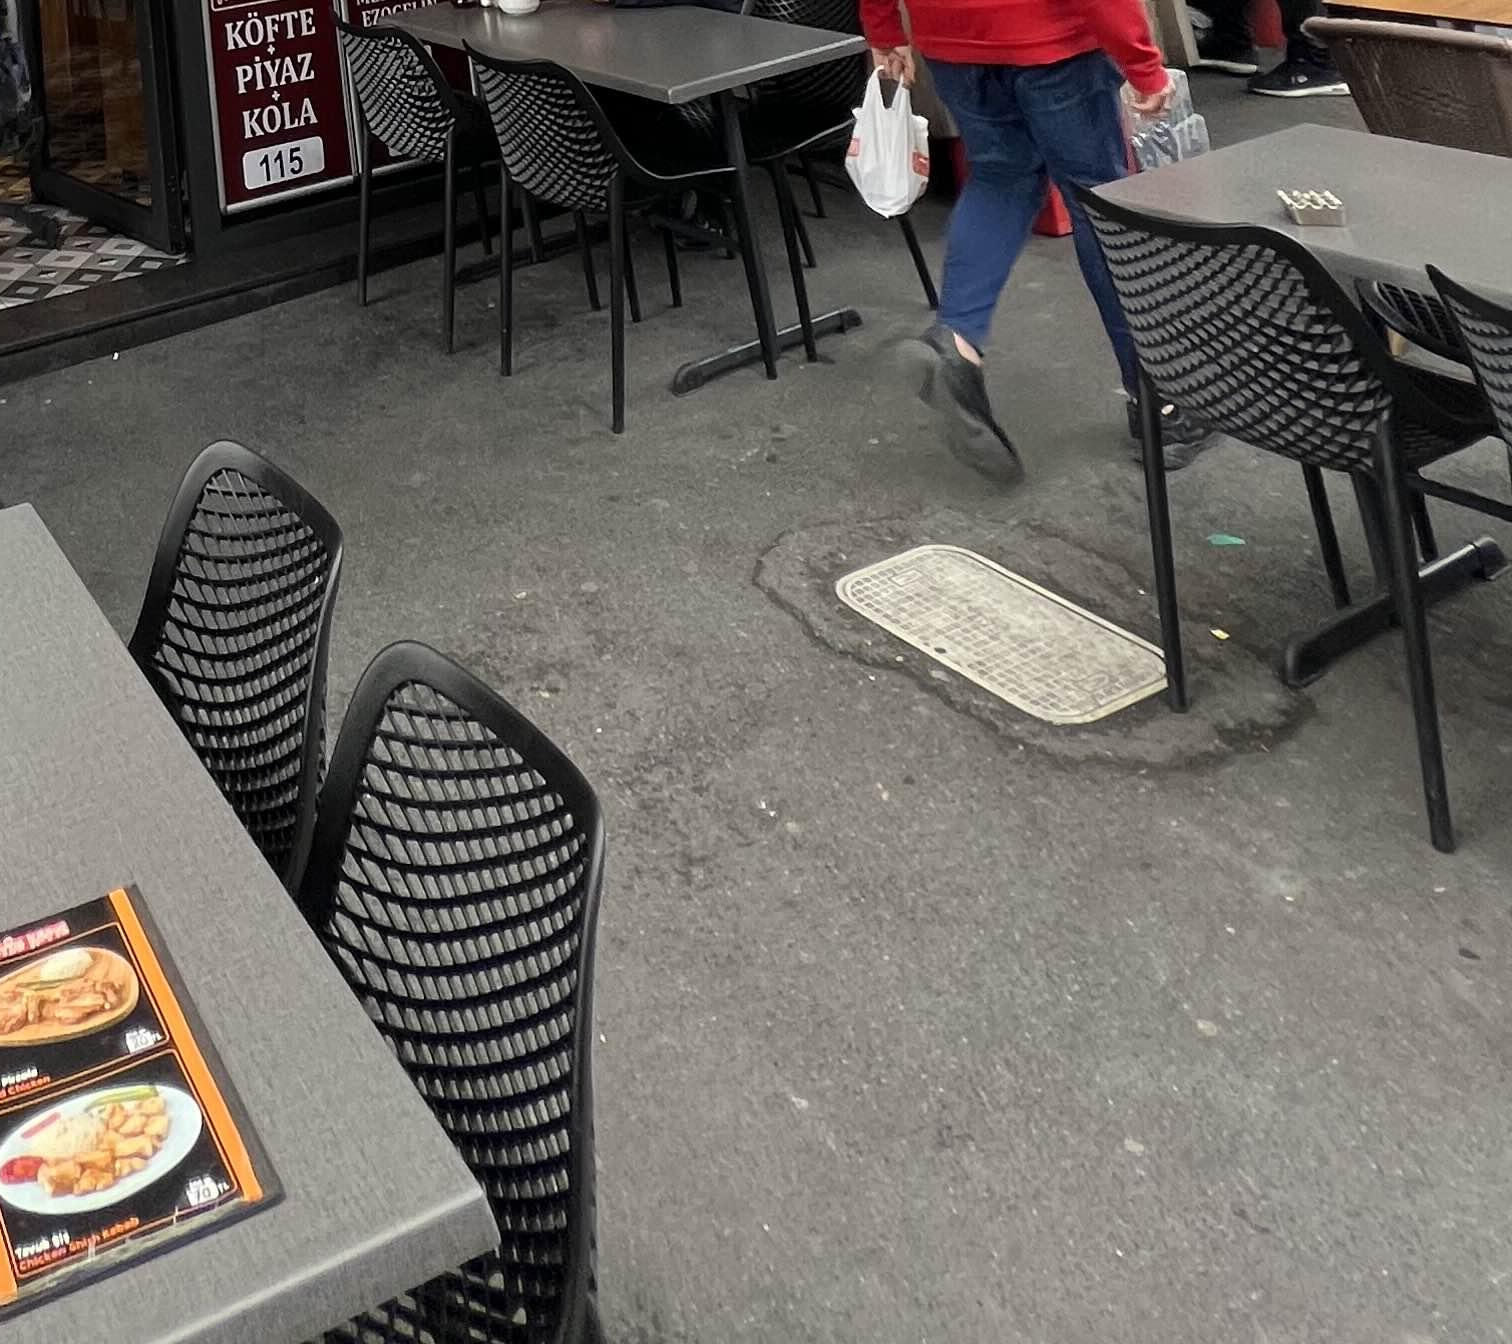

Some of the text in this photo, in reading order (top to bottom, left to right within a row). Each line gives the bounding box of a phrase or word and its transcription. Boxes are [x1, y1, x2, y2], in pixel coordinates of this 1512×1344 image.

[225, 8, 317, 51] KÖFTE
[235, 52, 316, 95] PİYAZ
[243, 97, 319, 140] KOLA
[259, 146, 305, 183] 115
